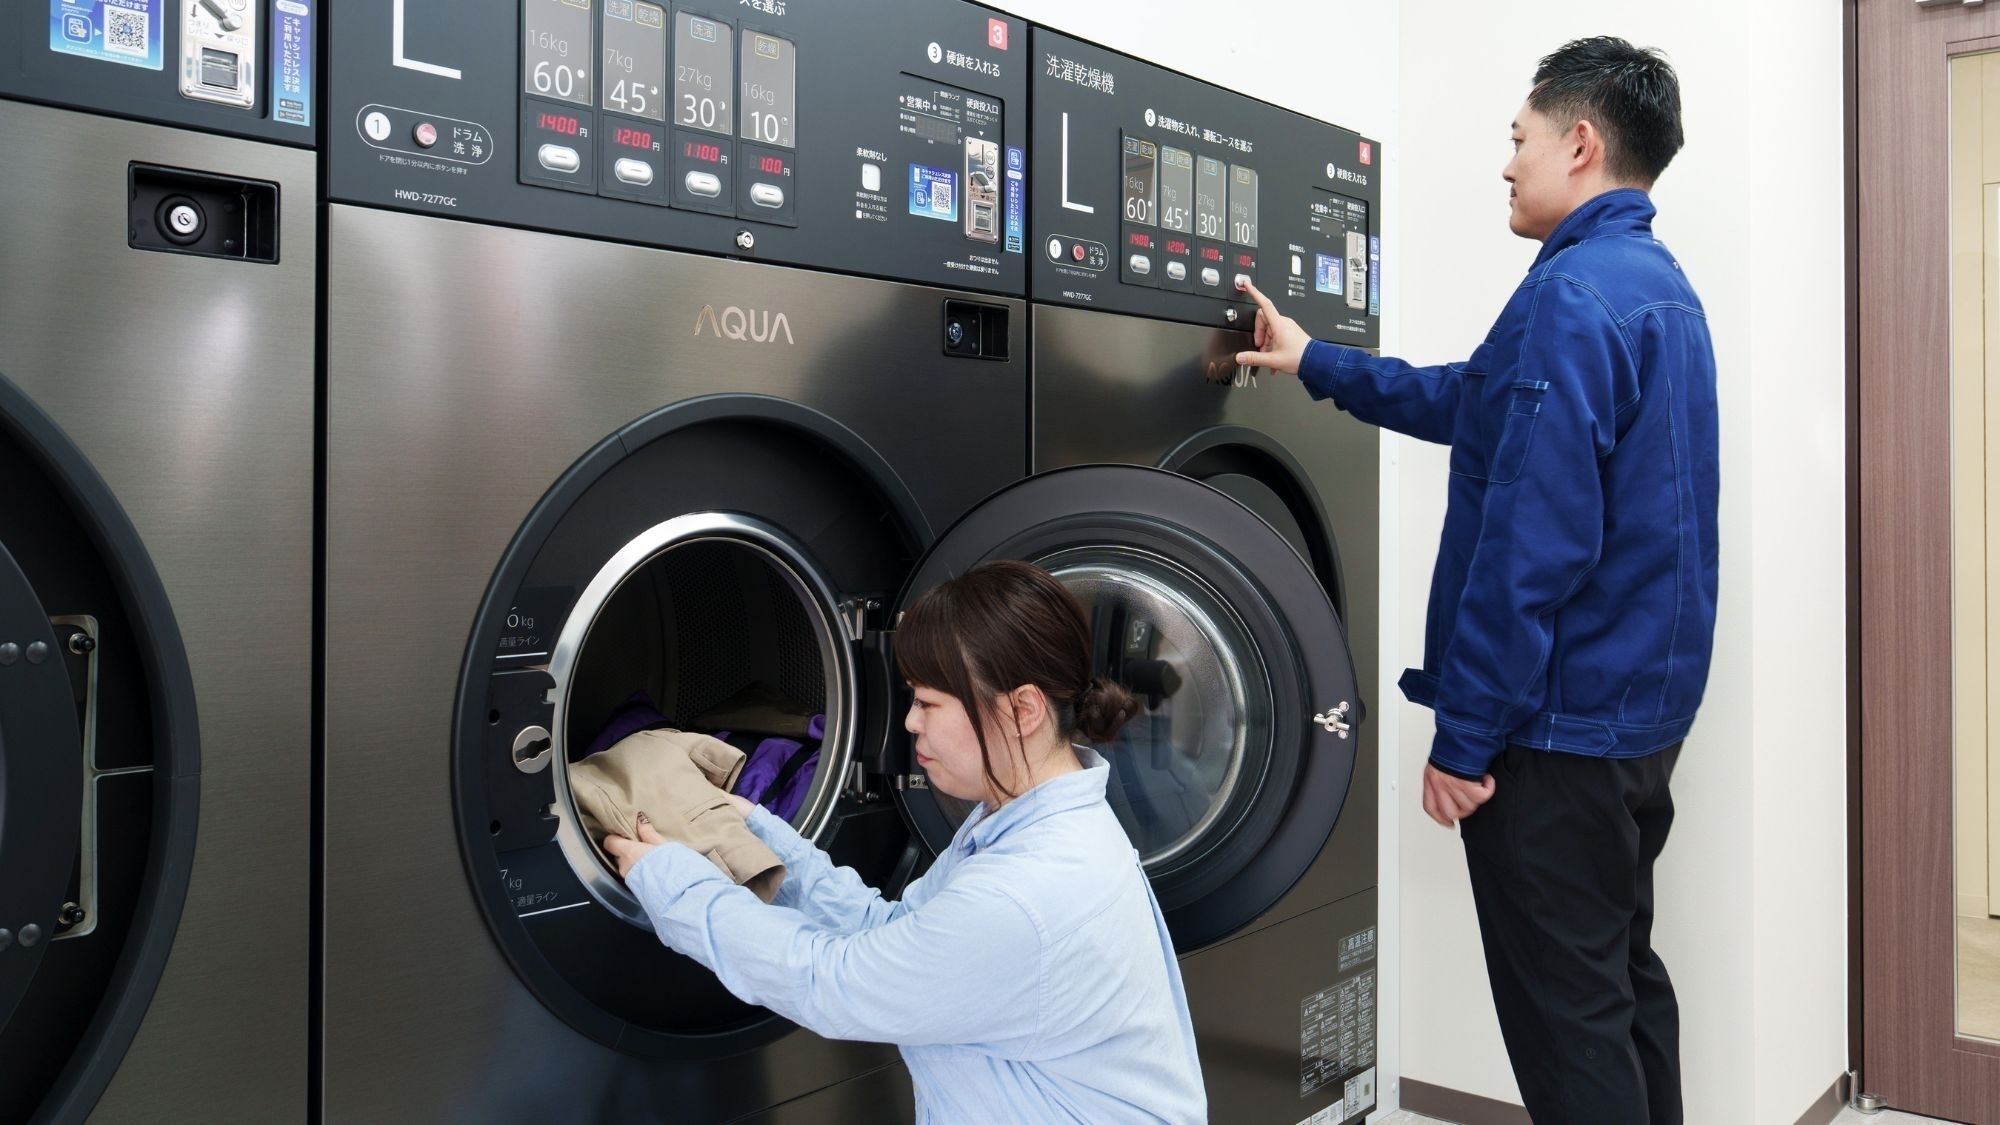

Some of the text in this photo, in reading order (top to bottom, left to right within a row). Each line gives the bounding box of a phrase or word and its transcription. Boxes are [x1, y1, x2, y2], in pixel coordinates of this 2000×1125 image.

[530, 29, 568, 57] 16kg
[992, 24, 1003, 45] 3
[607, 48, 633, 73] 7kg
[946, 50, 1000, 77] 硬貨を入れる
[534, 61, 573, 97] 60
[678, 65, 712, 91] 27kg
[1046, 53, 1115, 95] 洗濯乾燥機
[610, 79, 646, 113] 45
[744, 82, 774, 106] 16kg
[906, 95, 931, 112] 営業中
[683, 94, 716, 128] 30
[453, 127, 483, 143] ドラム
[540, 113, 588, 137] 1400 円
[751, 111, 779, 143] 10
[616, 128, 660, 151] 1200 円
[379, 154, 468, 175] ドアを閉じ1分以内にボタンを押す
[720, 155, 728, 165] 円
[783, 167, 791, 177] 円
[1062, 112, 1094, 214] L
[395, 189, 457, 207] HWD-7277GC
[1127, 197, 1147, 221] 60
[1164, 206, 1183, 229] 45
[1200, 212, 1217, 236] 30
[1235, 221, 1250, 244] 10
[693, 304, 795, 345] AQUA
